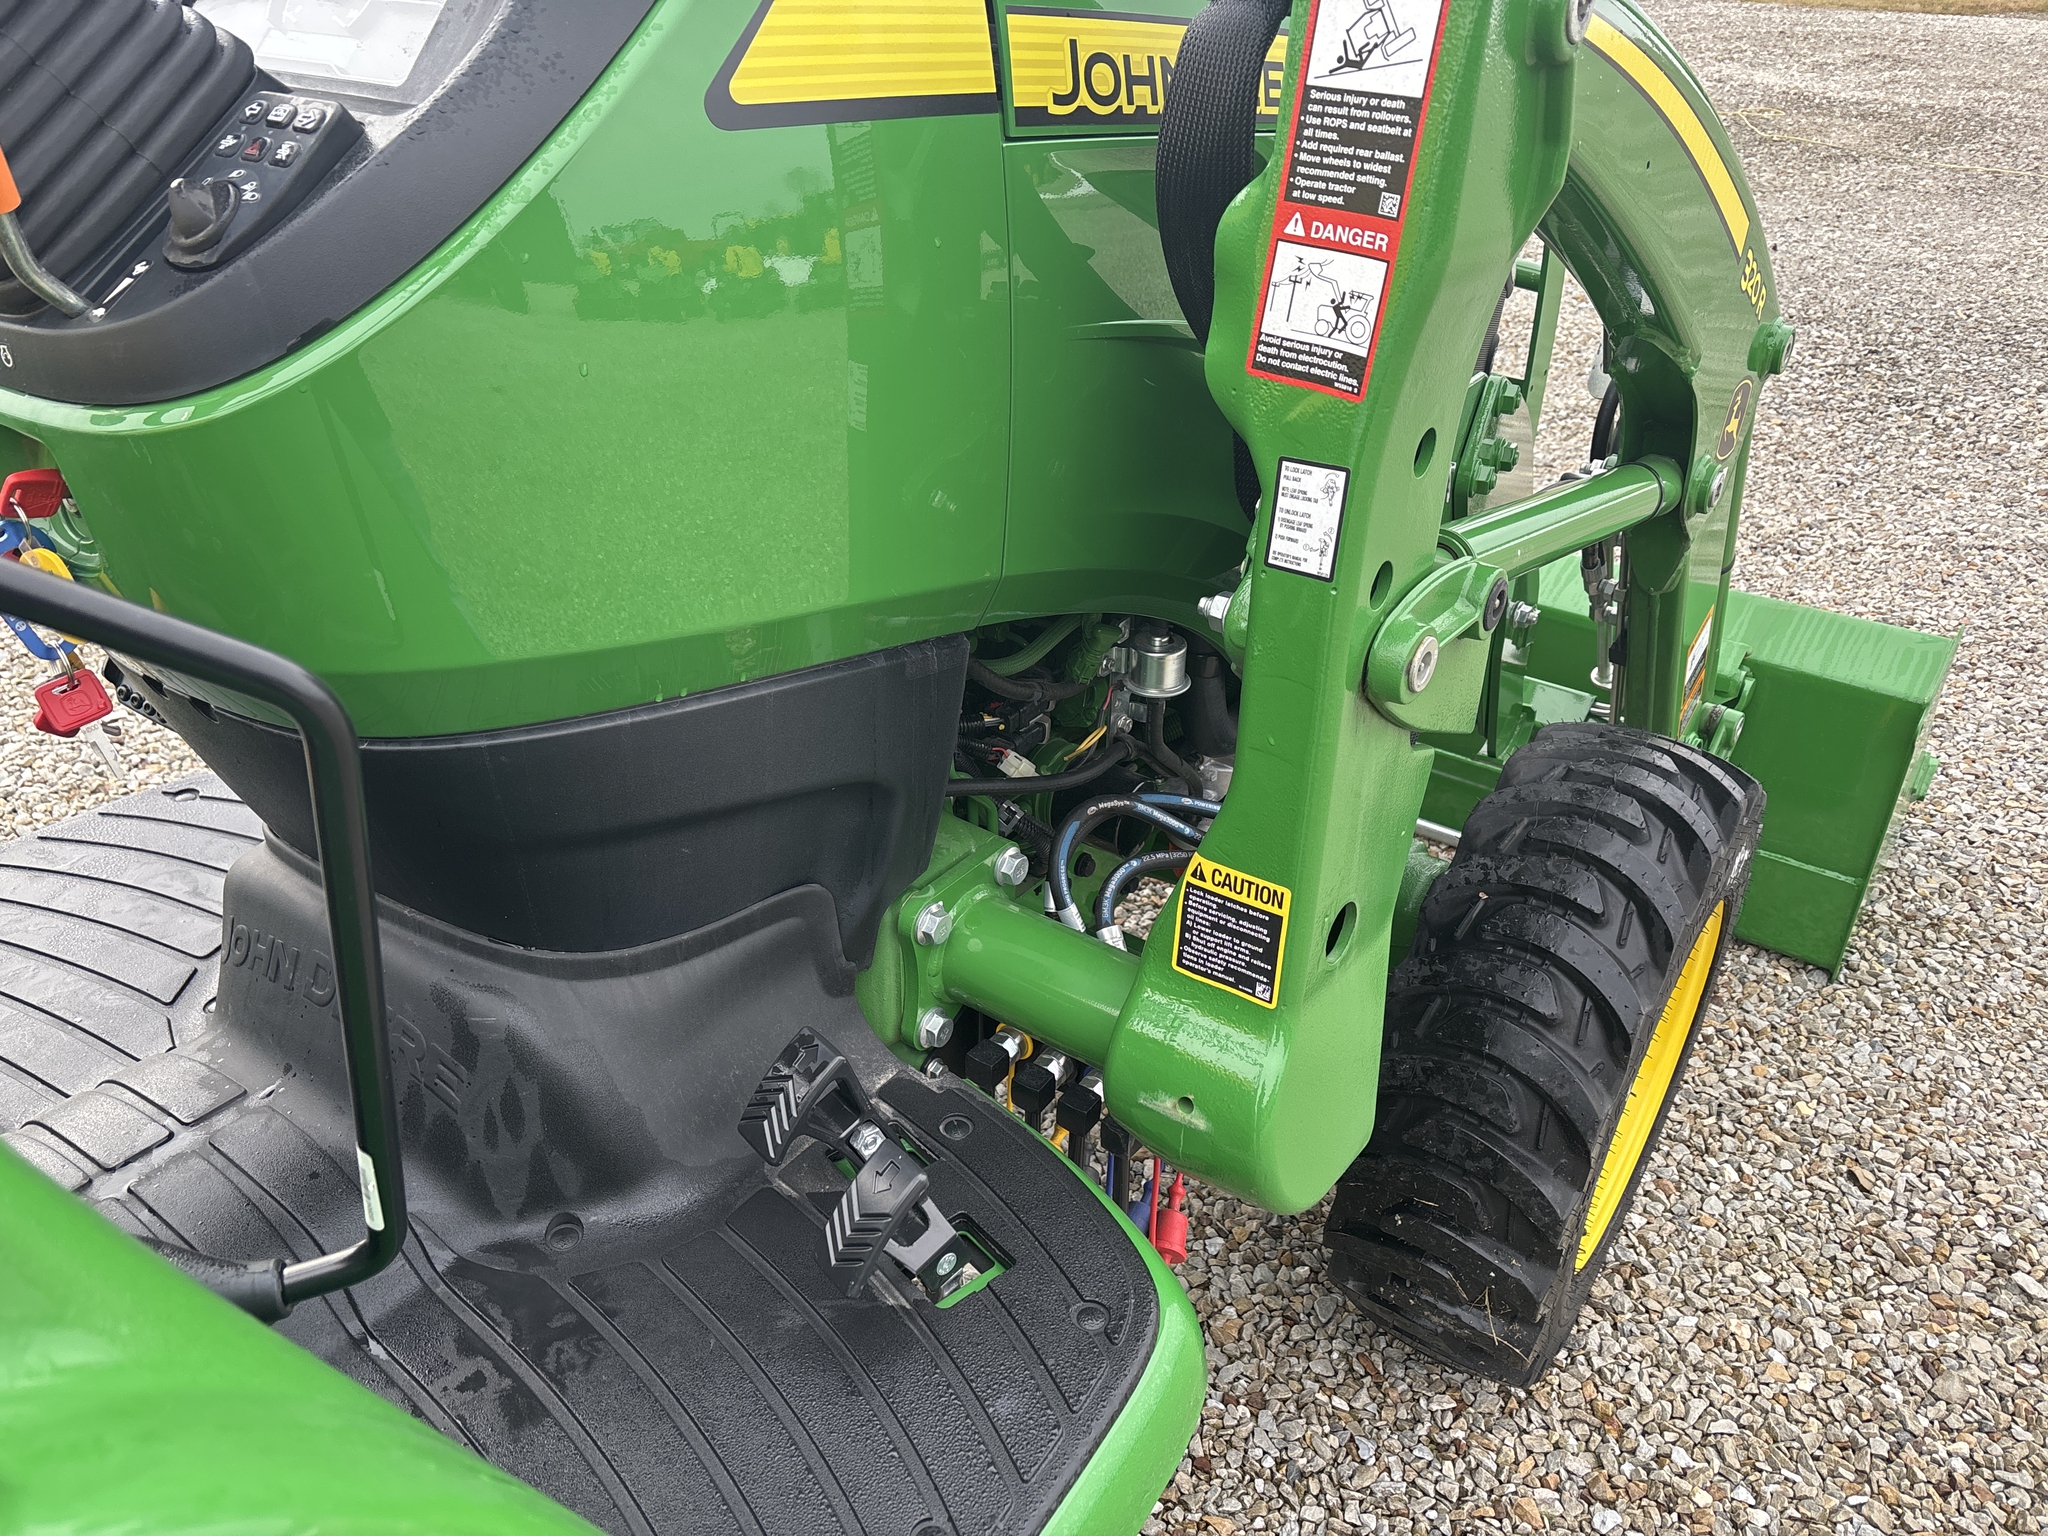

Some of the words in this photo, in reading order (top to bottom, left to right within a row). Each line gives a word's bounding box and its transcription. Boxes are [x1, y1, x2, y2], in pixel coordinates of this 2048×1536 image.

[1310, 89, 1342, 102] Serious
[1343, 93, 1368, 107] injury
[1369, 98, 1380, 106] or
[1380, 98, 1406, 109] death
[1307, 103, 1323, 112] can
[1324, 106, 1349, 116] result
[1350, 107, 1370, 118] from
[1371, 110, 1412, 124] rollovers.
[1303, 127, 1314, 137] all
[1315, 129, 1339, 140] times.
[1305, 114, 1322, 125] Use
[1323, 116, 1348, 129] ROPS
[1349, 121, 1366, 131] and
[1367, 124, 1402, 136] seatbelt
[1402, 128, 1412, 137] at
[1299, 151, 1321, 163] Move
[1322, 156, 1351, 167] wheels
[1353, 159, 1362, 169] to
[1363, 162, 1392, 174] widest
[1301, 139, 1319, 150] Add
[1319, 144, 1355, 155] required
[1355, 148, 1373, 158] rear
[1374, 149, 1405, 163] ballast.
[1294, 176, 1327, 190] Operate
[1328, 182, 1356, 194] tractor
[1296, 166, 1355, 181] recommended
[1356, 174, 1387, 188] setting.
[1292, 190, 1301, 198] at
[1302, 190, 1317, 200] low
[1317, 194, 1345, 205] speed.
[1310, 220, 1389, 253] DANGER
[1741, 250, 1766, 321] 320R
[1259, 333, 1281, 345] Avoid
[1282, 338, 1310, 352] serious
[1311, 343, 1334, 359] injury
[1334, 350, 1344, 359] or
[1258, 343, 1279, 355] death
[1279, 348, 1297, 359] from
[1298, 353, 1349, 373] electrocution.
[1256, 353, 1267, 363] Do
[1267, 358, 1281, 366] not
[1281, 361, 1309, 373] contact
[1310, 366, 1338, 380] electric
[1338, 373, 1359, 387] lines.
[1156, 852, 1170, 860] MPa
[1211, 868, 1285, 910] CAUTION
[222, 914, 299, 991] JOHN
